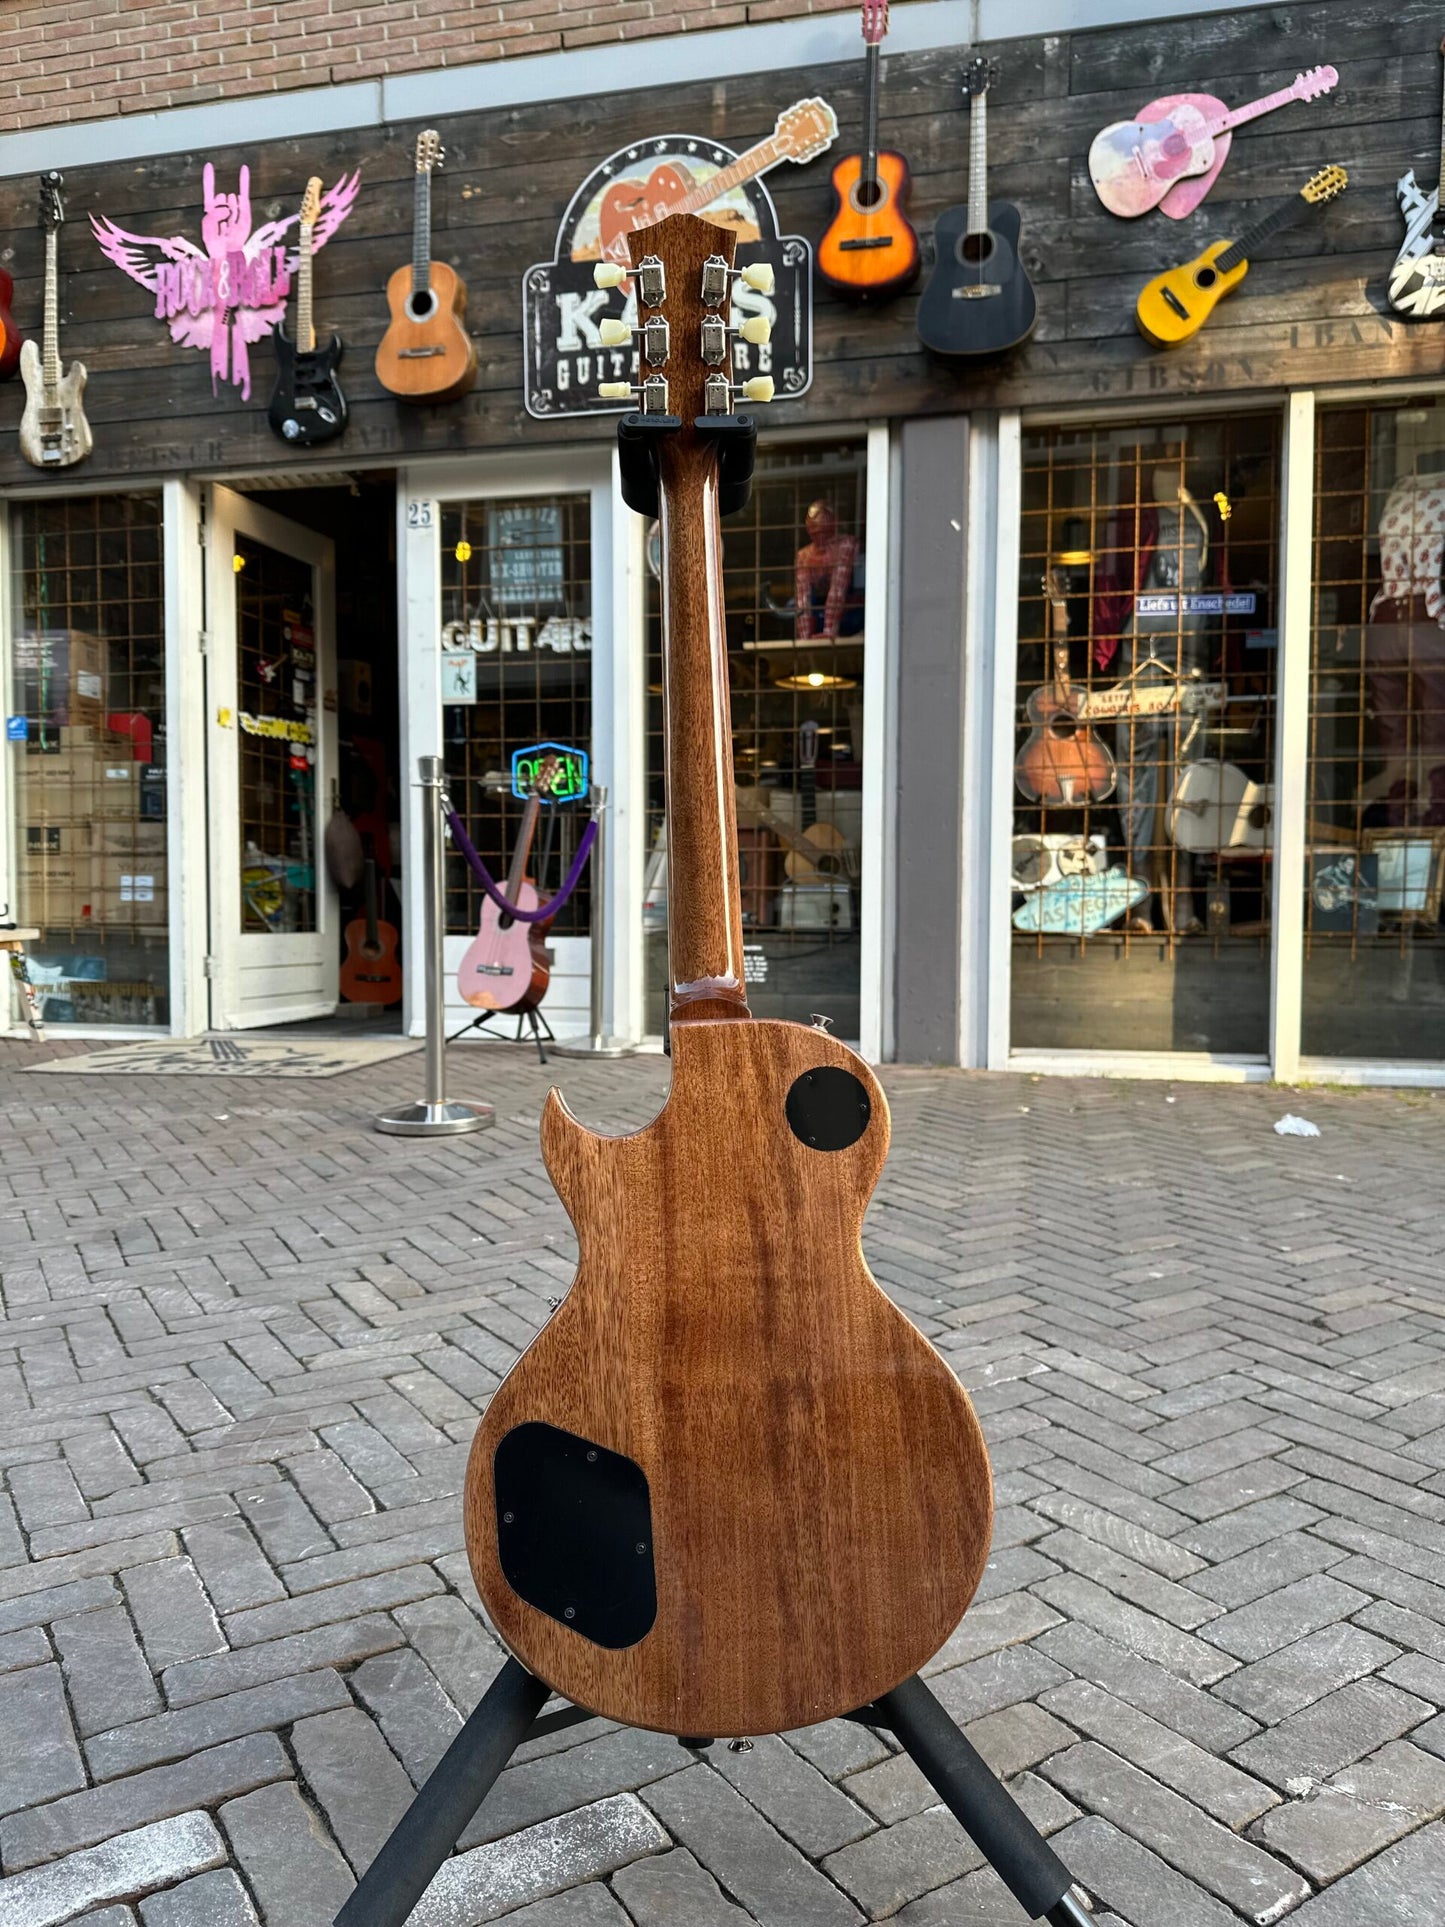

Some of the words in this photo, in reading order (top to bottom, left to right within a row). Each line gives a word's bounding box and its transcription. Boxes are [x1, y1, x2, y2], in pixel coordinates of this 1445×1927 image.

[154, 256, 217, 319] ROCK
[217, 260, 231, 299] &
[231, 246, 290, 308] ROLL
[409, 502, 432, 525] 25
